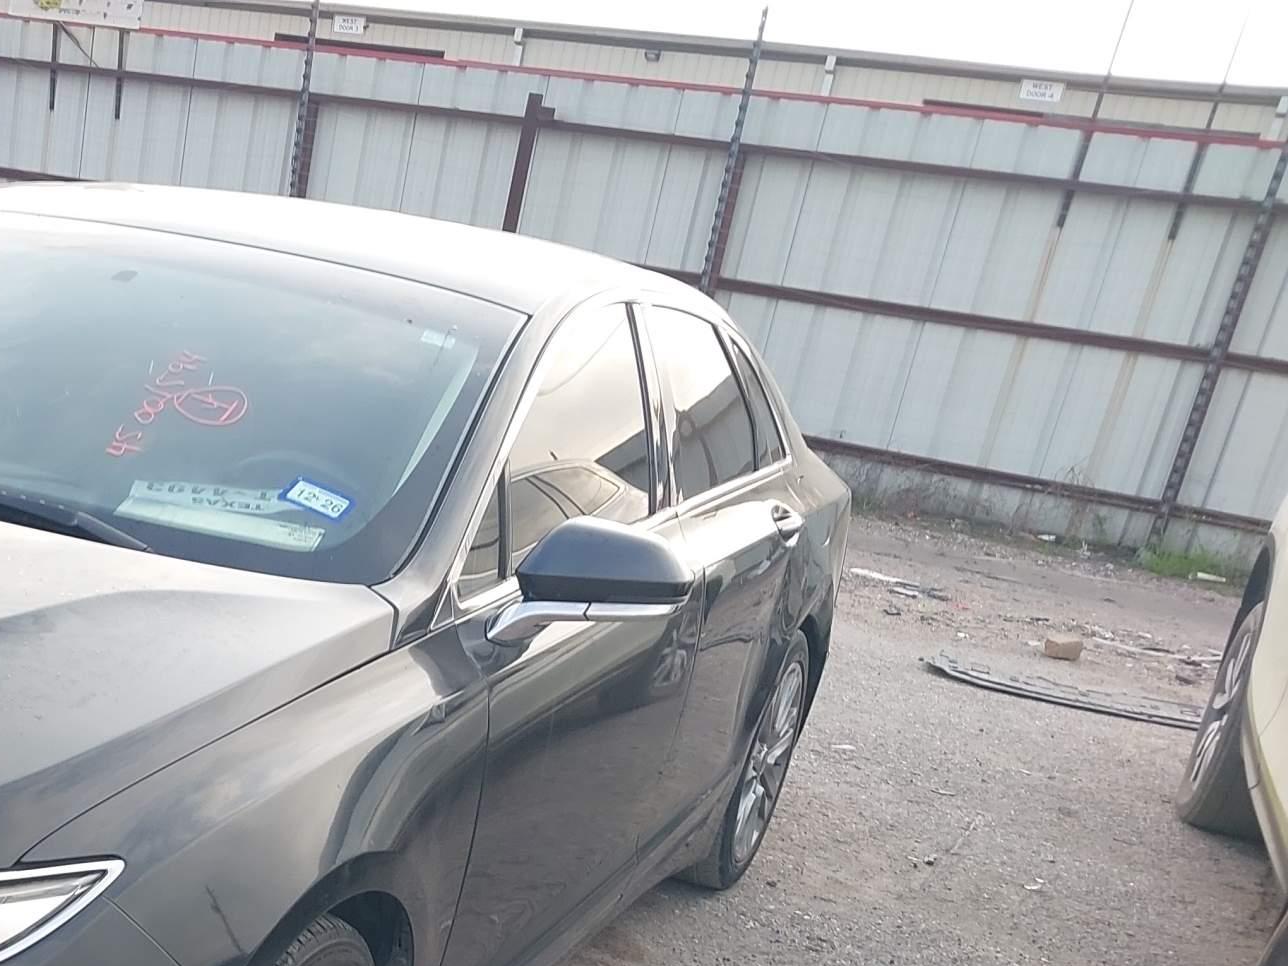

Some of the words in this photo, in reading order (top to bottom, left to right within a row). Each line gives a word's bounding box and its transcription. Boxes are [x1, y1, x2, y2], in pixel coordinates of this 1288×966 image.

[1032, 81, 1053, 90] WEST
[1026, 89, 1047, 98] DOOR
[191, 497, 265, 511] TEXAS
[320, 498, 344, 514] 26
